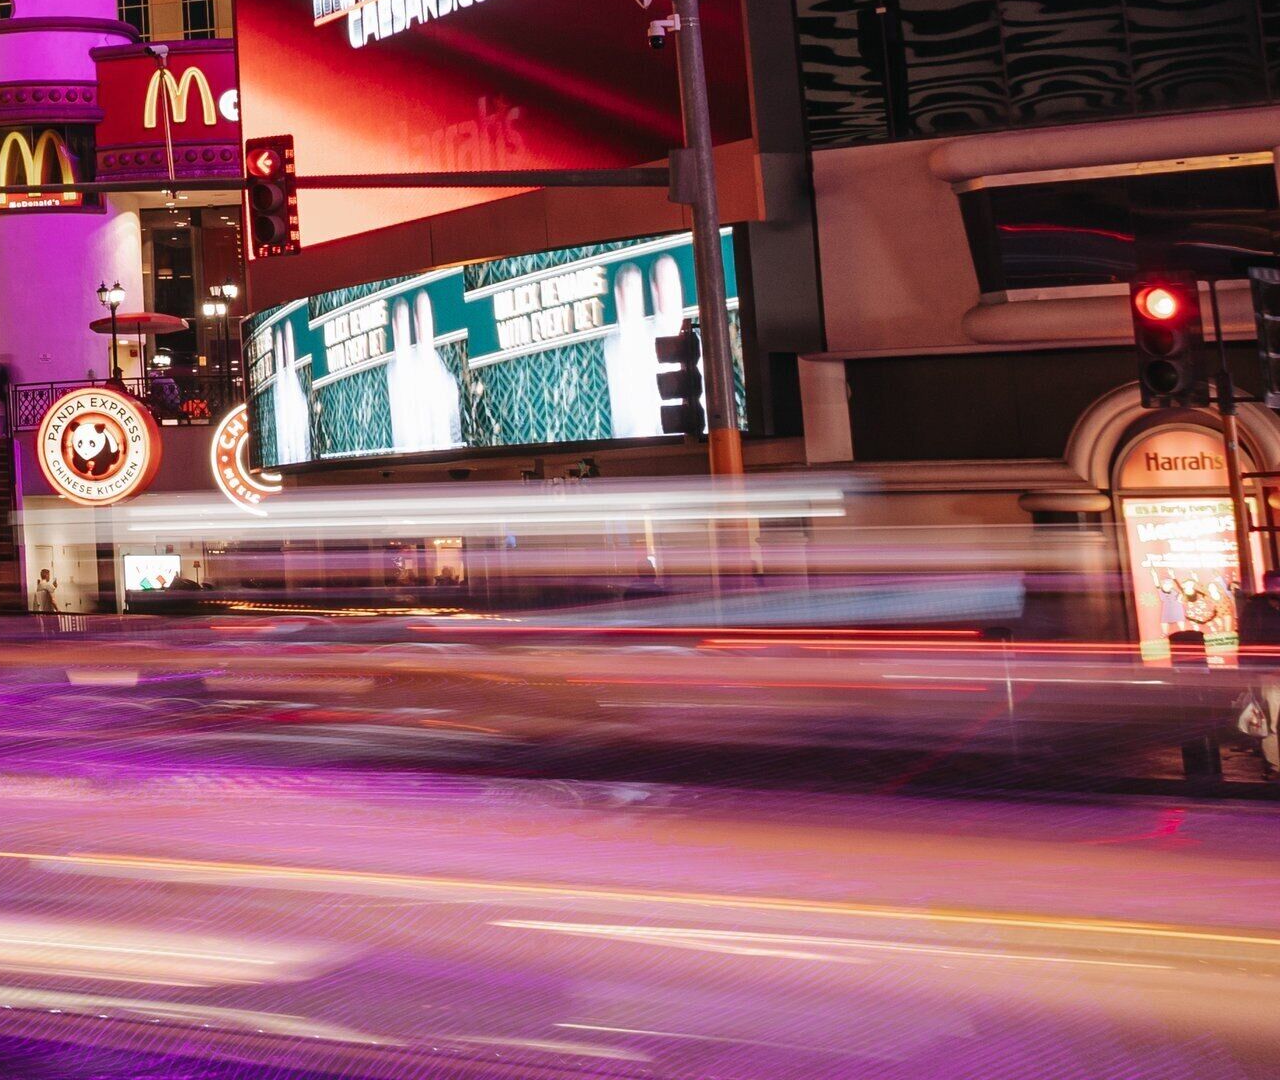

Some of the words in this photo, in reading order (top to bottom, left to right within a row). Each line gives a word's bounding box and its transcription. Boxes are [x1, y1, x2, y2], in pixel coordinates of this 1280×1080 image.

[8, 198, 61, 209] McDonald's
[48, 400, 86, 442] PANDA
[90, 397, 141, 443] EXPRESS
[52, 459, 93, 495] CHINESE
[97, 462, 138, 496] KITCHEN
